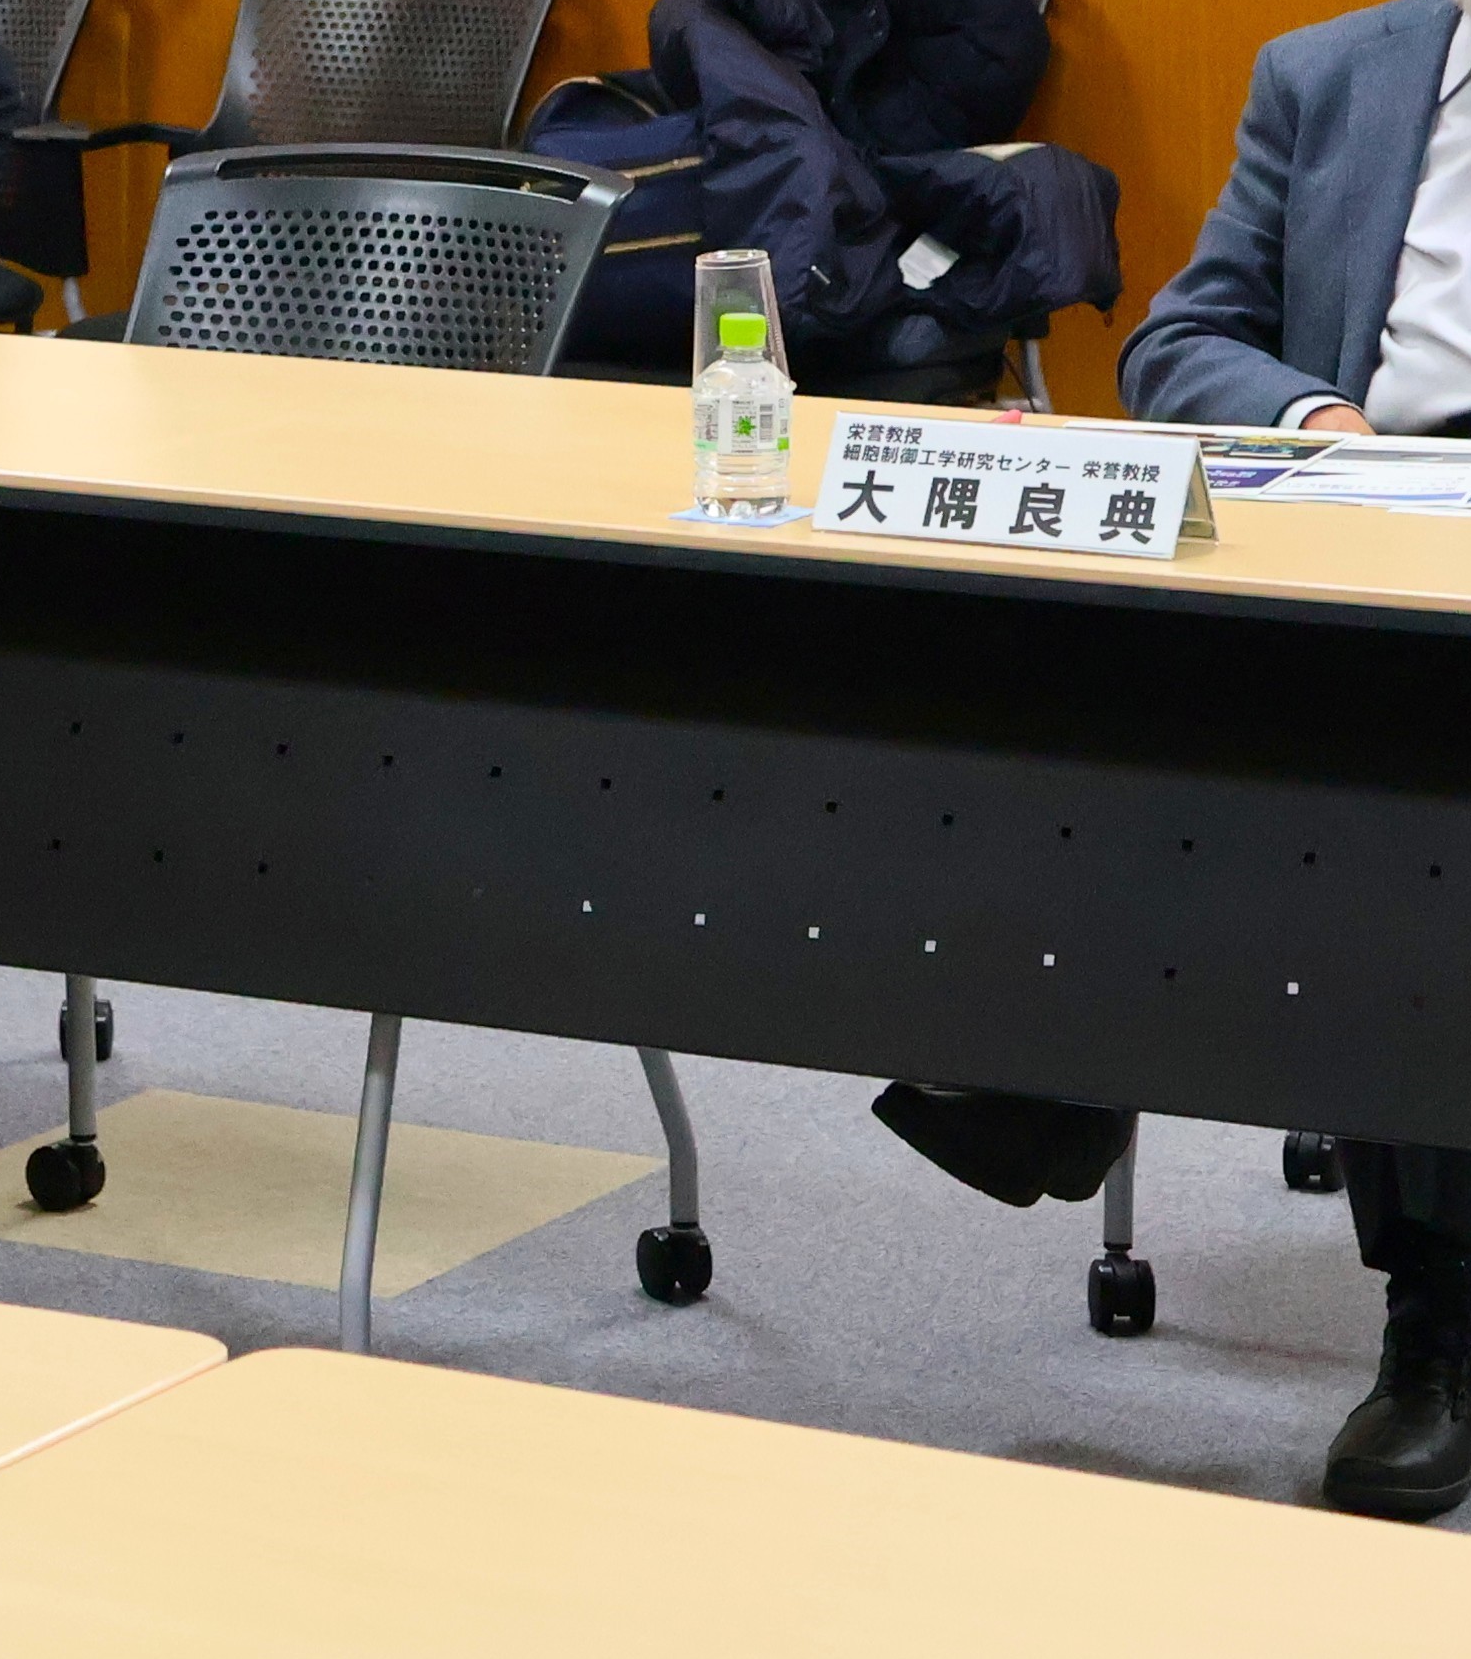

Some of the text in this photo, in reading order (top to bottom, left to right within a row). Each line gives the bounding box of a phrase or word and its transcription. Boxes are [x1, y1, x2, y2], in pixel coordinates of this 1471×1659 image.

[846, 423, 924, 445] 栄誉教授
[842, 444, 1161, 484] 細胞制御工学研究センター 栄誉教授
[837, 469, 1157, 545] 大隅良典
